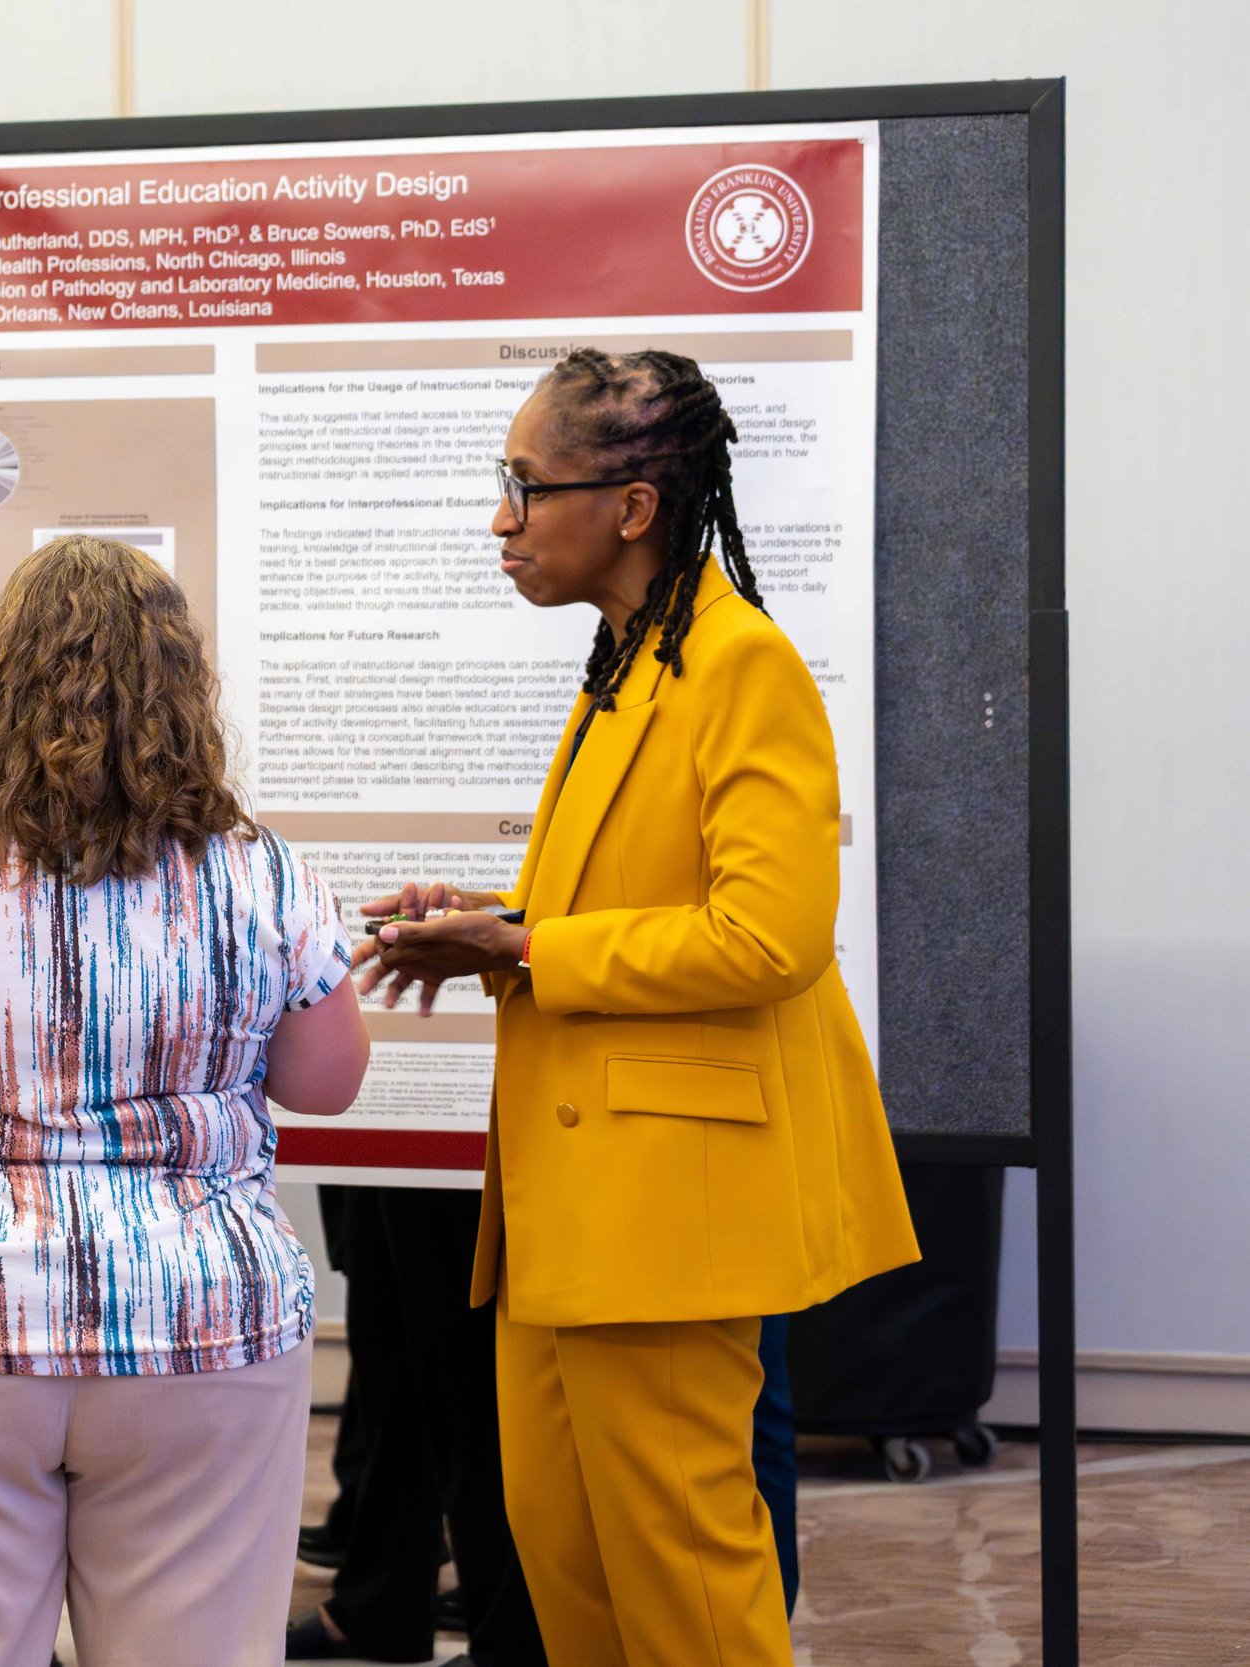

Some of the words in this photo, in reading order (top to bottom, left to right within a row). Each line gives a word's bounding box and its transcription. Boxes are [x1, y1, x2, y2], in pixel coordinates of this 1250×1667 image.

[139, 178, 267, 203] Education
[273, 174, 367, 202] Activity
[376, 171, 467, 200] Design
[694, 196, 716, 266] ROSALIND
[710, 173, 776, 198] FRANKLIN
[777, 184, 804, 262] UNIVERSITY
[88, 229, 133, 247] DDS,
[139, 228, 187, 245] MPH,
[248, 224, 263, 242] &
[267, 224, 319, 241] Bruce
[324, 223, 395, 239] Sowers,
[400, 219, 444, 237] PhD,
[47, 255, 150, 272] Professions,
[156, 252, 204, 269] North
[208, 251, 285, 270] Chicago,
[291, 248, 346, 264] Illinois
[30, 279, 48, 297] of
[52, 279, 136, 298] Pathology
[140, 277, 173, 293] and
[178, 276, 272, 294] Laboratory
[276, 272, 360, 289] Medicine,
[366, 271, 446, 287] Houston,
[451, 268, 505, 285] Texas
[68, 304, 106, 319] New
[110, 302, 182, 319] Orleans,
[188, 300, 272, 317] Louisiana
[258, 384, 324, 394] Implications
[328, 383, 343, 391] for
[347, 383, 364, 391] the
[368, 382, 402, 392] Usage
[406, 381, 417, 390] of
[420, 380, 491, 389] Instructional
[259, 500, 326, 510] Implications
[329, 499, 344, 508] for
[348, 498, 442, 508] Interprofessional
[260, 632, 326, 641] Implications
[329, 631, 344, 639] for
[347, 630, 383, 639] Future
[386, 630, 439, 639] Research
